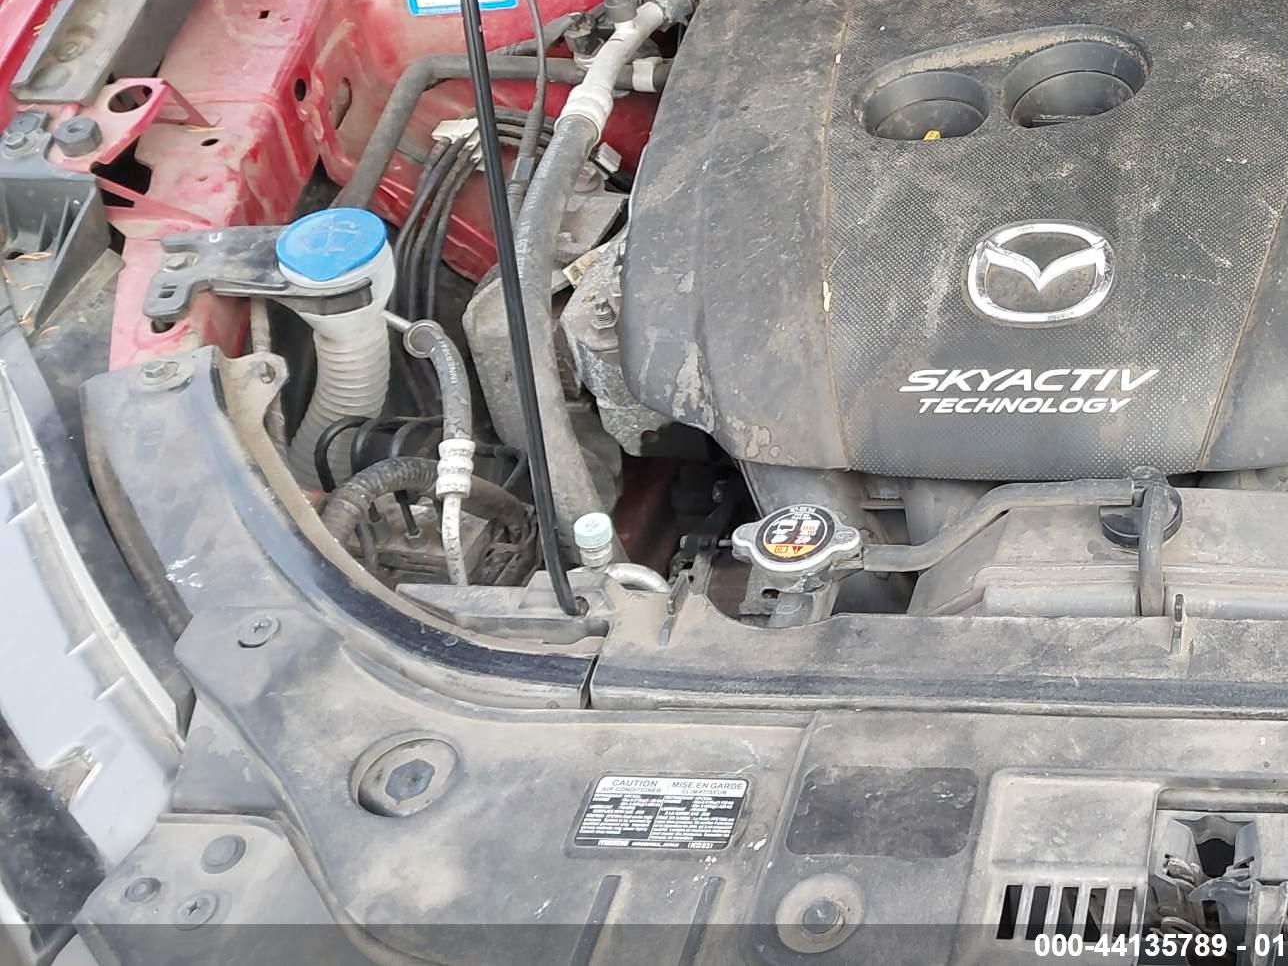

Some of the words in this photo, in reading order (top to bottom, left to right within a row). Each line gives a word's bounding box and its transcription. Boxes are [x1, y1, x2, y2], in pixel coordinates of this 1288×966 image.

[899, 368, 1160, 392] SKYACTIV
[919, 397, 1132, 414] TECHNOLOGY
[612, 779, 658, 787] CAUTION
[672, 781, 694, 789] MISE
[696, 781, 709, 789] EN
[710, 782, 744, 790] GARDE
